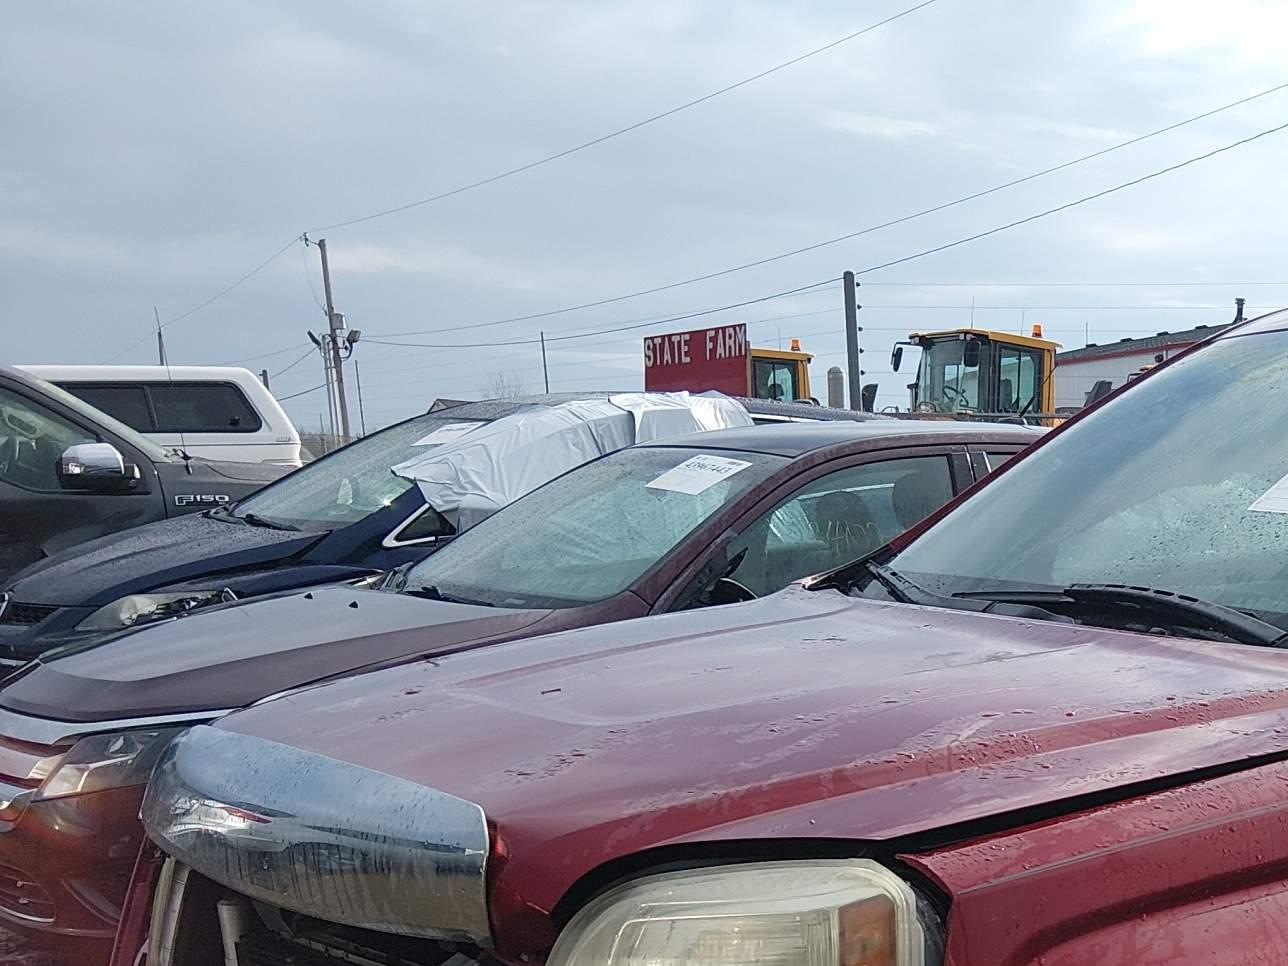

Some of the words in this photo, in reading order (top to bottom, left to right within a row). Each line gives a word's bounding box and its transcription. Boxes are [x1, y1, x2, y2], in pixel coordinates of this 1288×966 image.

[645, 334, 691, 368] STATE
[706, 325, 745, 360] FARM
[175, 495, 229, 505] F150
